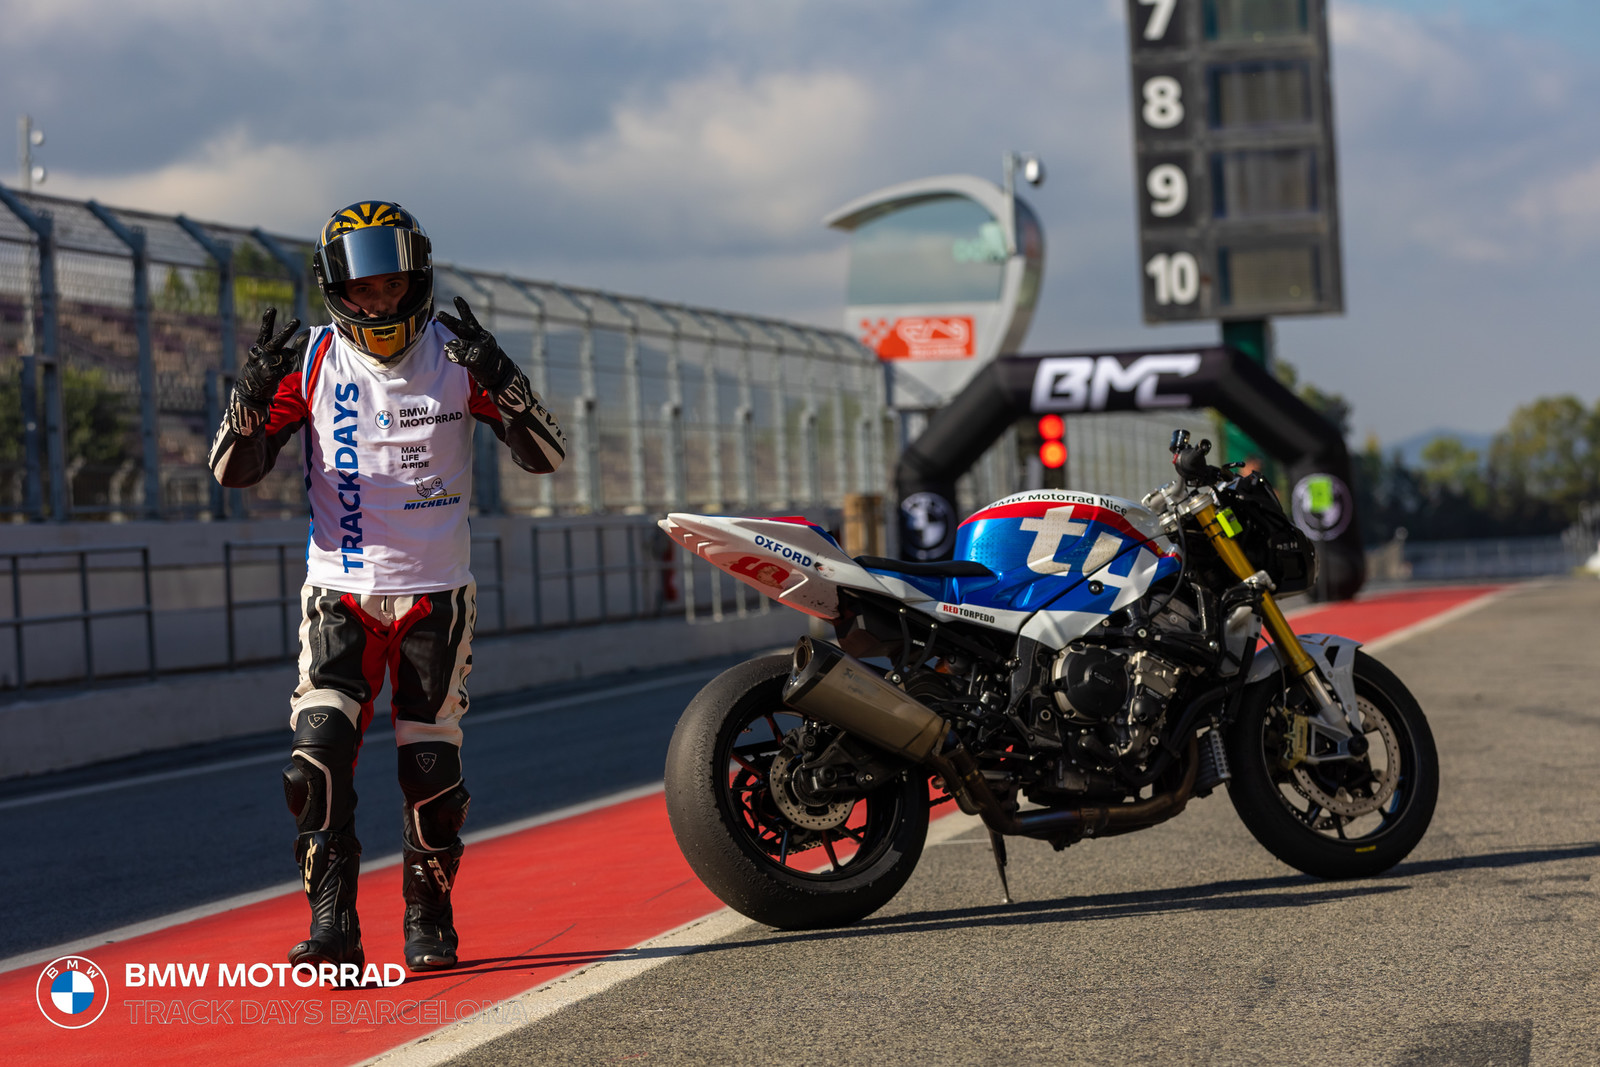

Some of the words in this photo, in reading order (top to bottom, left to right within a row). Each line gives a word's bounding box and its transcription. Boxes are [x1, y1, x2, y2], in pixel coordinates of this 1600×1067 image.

[1138, 0, 1177, 41] 7
[1142, 76, 1185, 129] 8
[1147, 164, 1188, 217] 9
[1146, 252, 1199, 305] 10
[1030, 353, 1201, 411] BMC
[399, 407, 429, 418] BMW
[400, 411, 463, 428] MOTORRAD
[401, 446, 427, 454] MAKE
[401, 454, 419, 462] LIFE
[333, 382, 364, 574] TRACKDAYS
[409, 461, 430, 469] RIDE
[403, 496, 461, 510] MICHELIN
[1028, 493, 1095, 505] Motorrad
[1099, 497, 1128, 516] Nice
[754, 535, 812, 567] OXFORD
